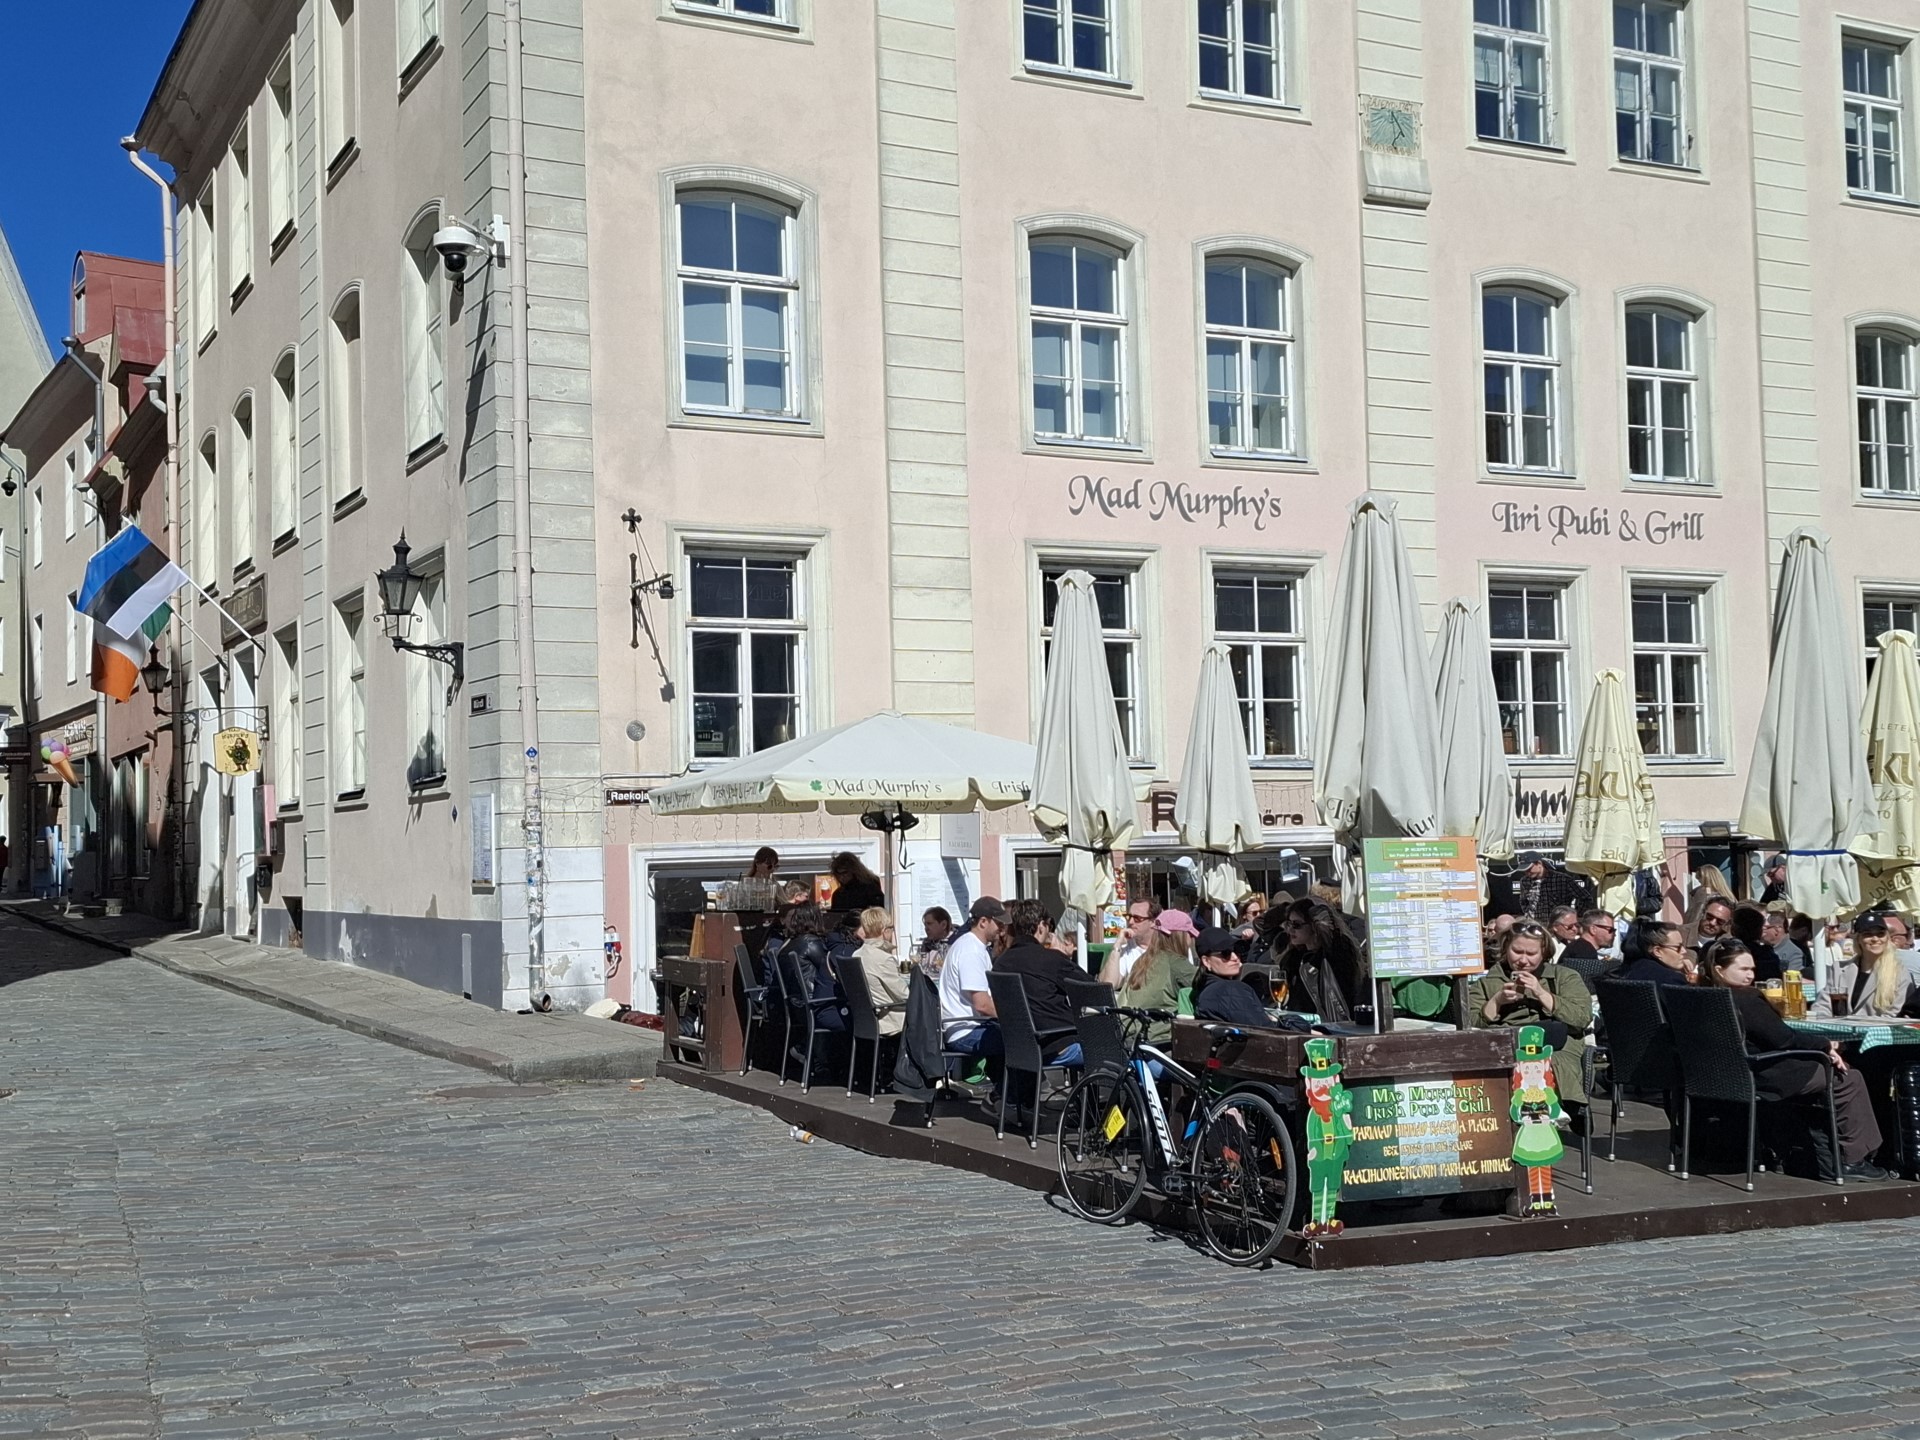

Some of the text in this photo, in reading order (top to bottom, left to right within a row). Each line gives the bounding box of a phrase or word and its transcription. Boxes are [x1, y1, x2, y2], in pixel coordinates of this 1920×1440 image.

[1068, 475, 1282, 531] Mad Murphy's
[1548, 505, 1611, 546] Pubi
[1618, 509, 1641, 542] &
[1645, 511, 1704, 545] Grill
[610, 791, 650, 802] Raekoja
[827, 778, 942, 798] Mad Murphy's
[991, 781, 1031, 793] Irish
[1147, 1090, 1173, 1154] SCOTT
